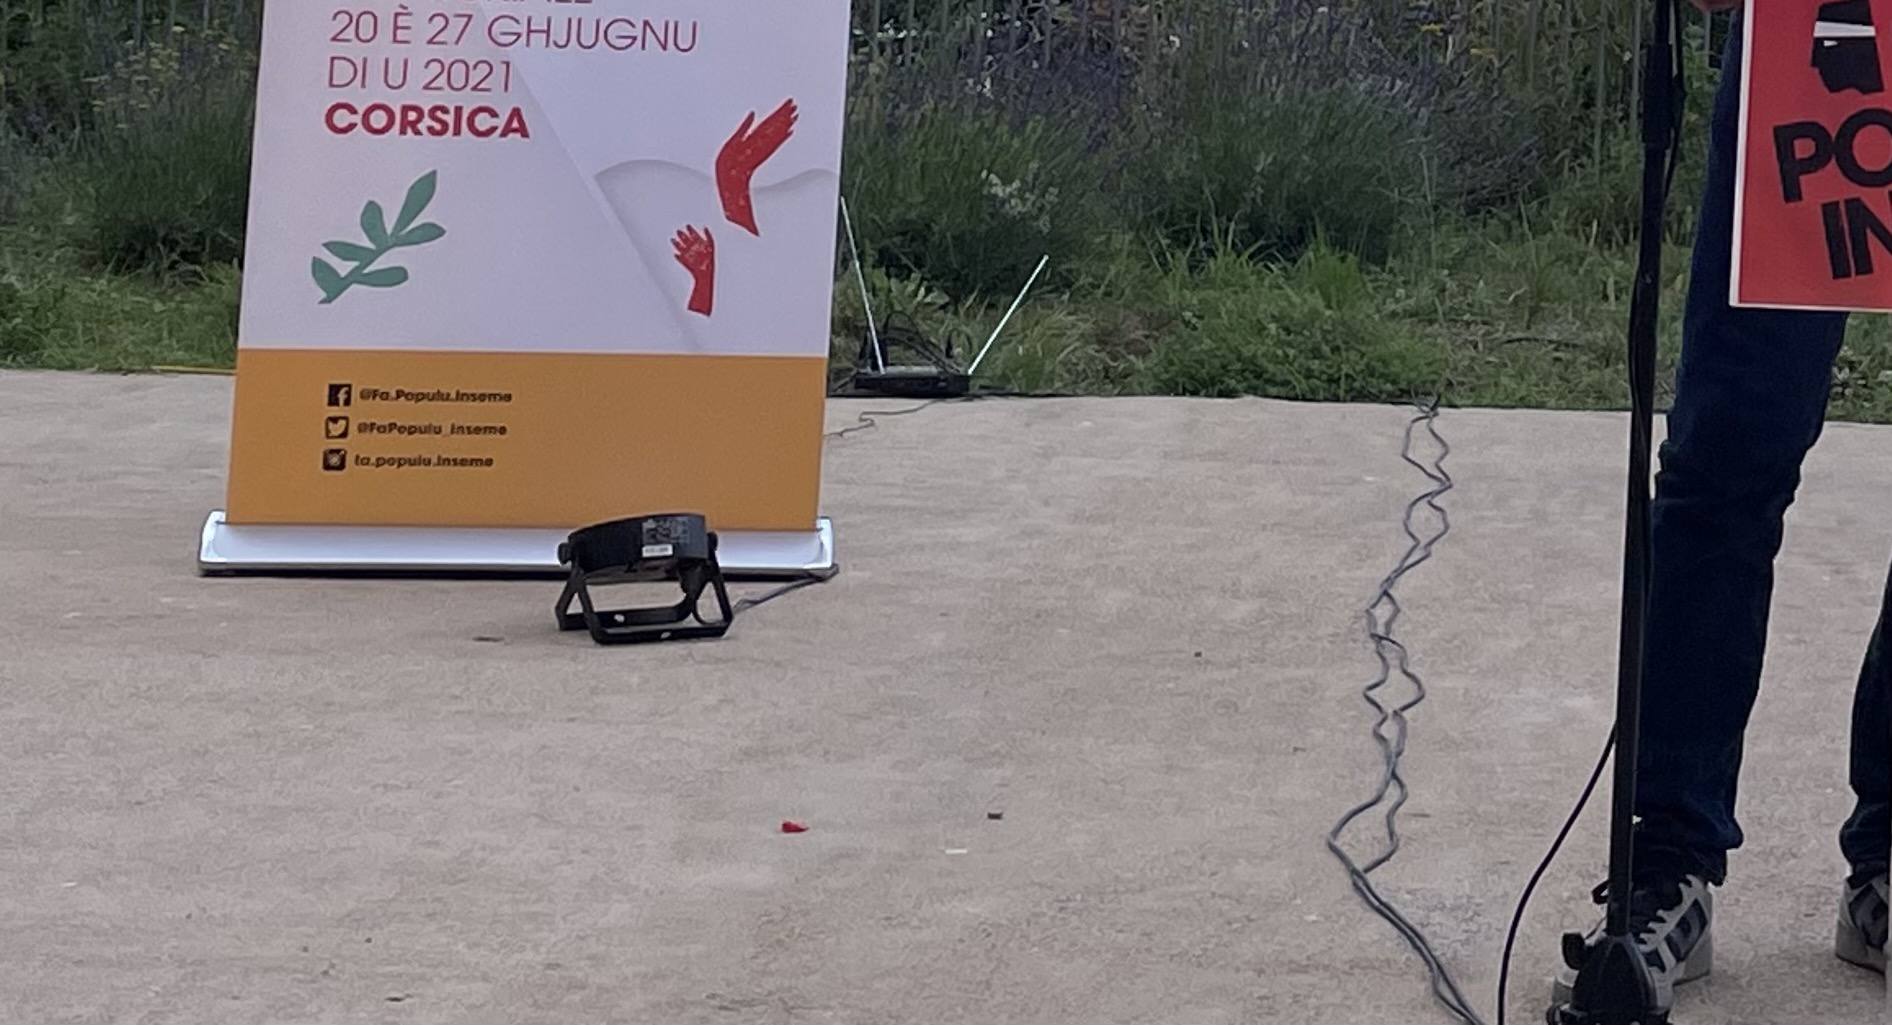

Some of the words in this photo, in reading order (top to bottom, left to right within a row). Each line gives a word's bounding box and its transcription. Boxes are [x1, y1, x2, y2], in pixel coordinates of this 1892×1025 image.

[330, 11, 378, 43] 20
[392, 5, 411, 44] È
[426, 13, 473, 46] 27
[487, 15, 698, 53] GHJUGNU
[327, 57, 368, 89] DI
[382, 59, 407, 91] U
[422, 60, 512, 93] 2021
[324, 101, 530, 139] CORSICA
